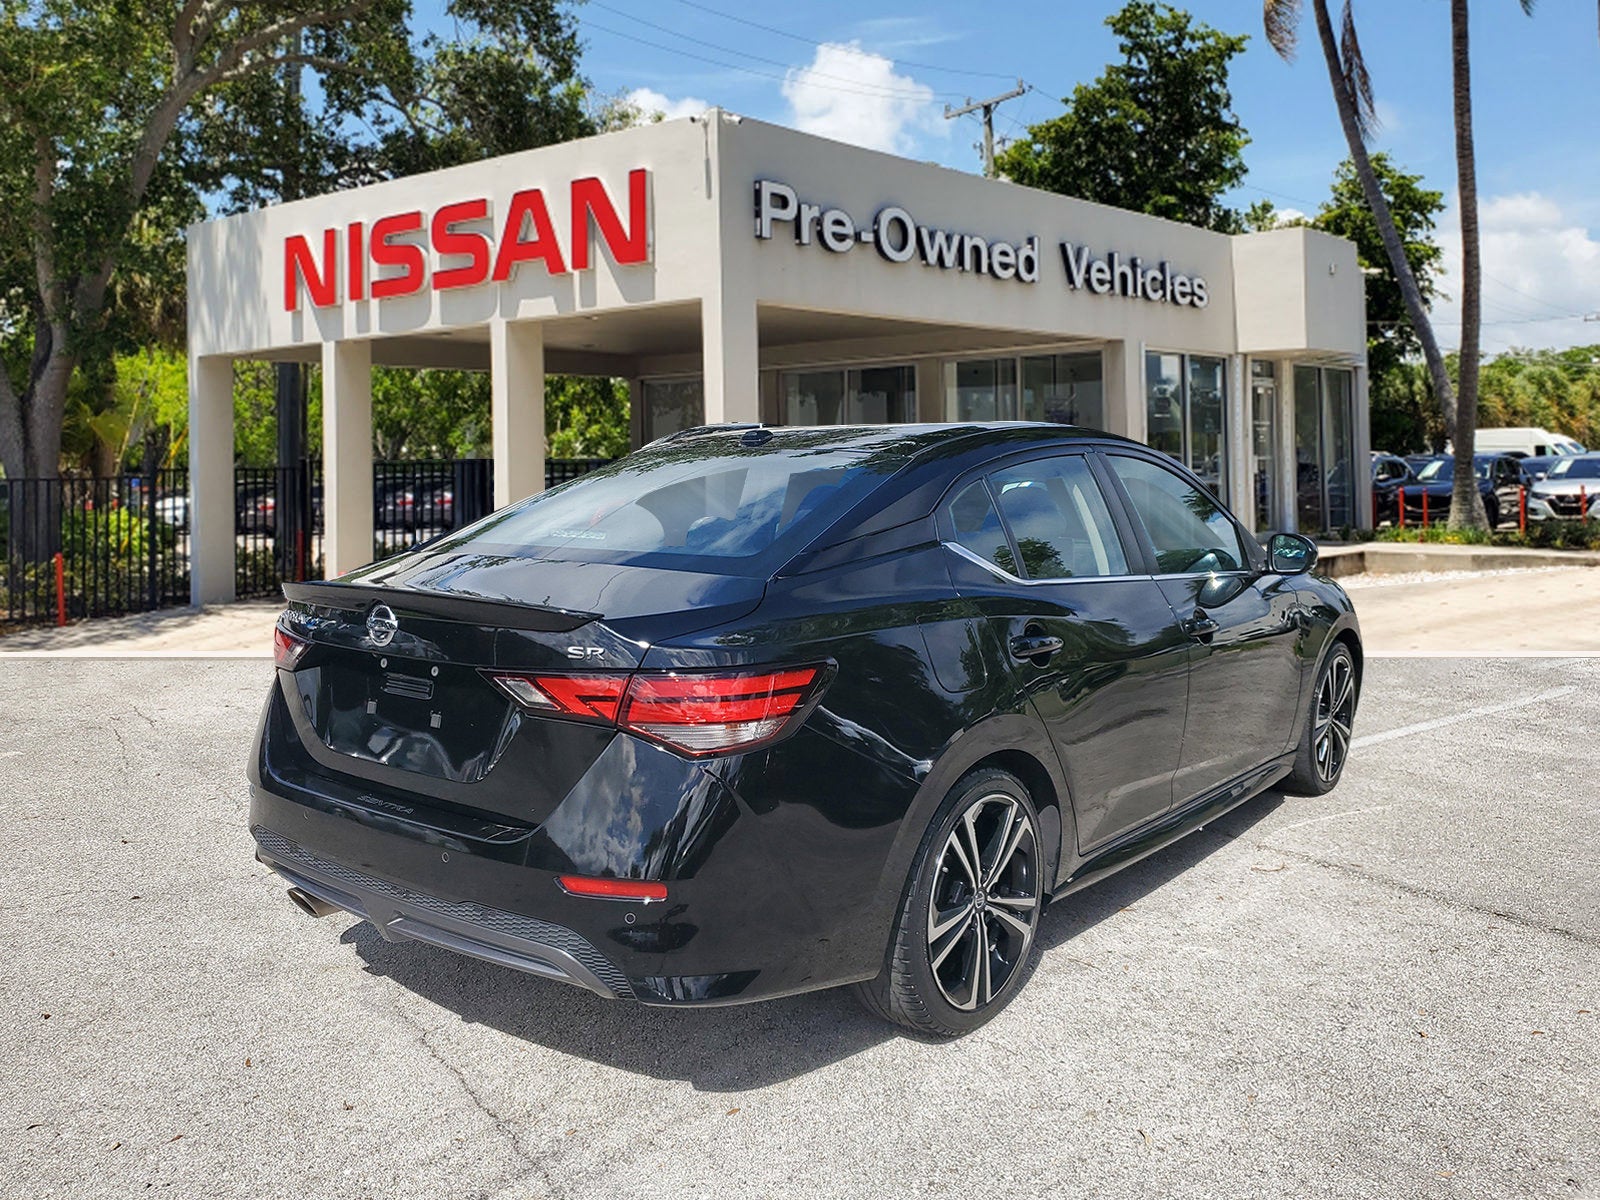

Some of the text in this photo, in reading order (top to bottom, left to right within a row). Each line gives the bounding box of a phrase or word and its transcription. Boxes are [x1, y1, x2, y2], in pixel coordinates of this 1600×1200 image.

[284, 168, 647, 312] NISSAN
[755, 179, 1209, 308] Pre-Owned Vehicles
[567, 646, 605, 661] SR
